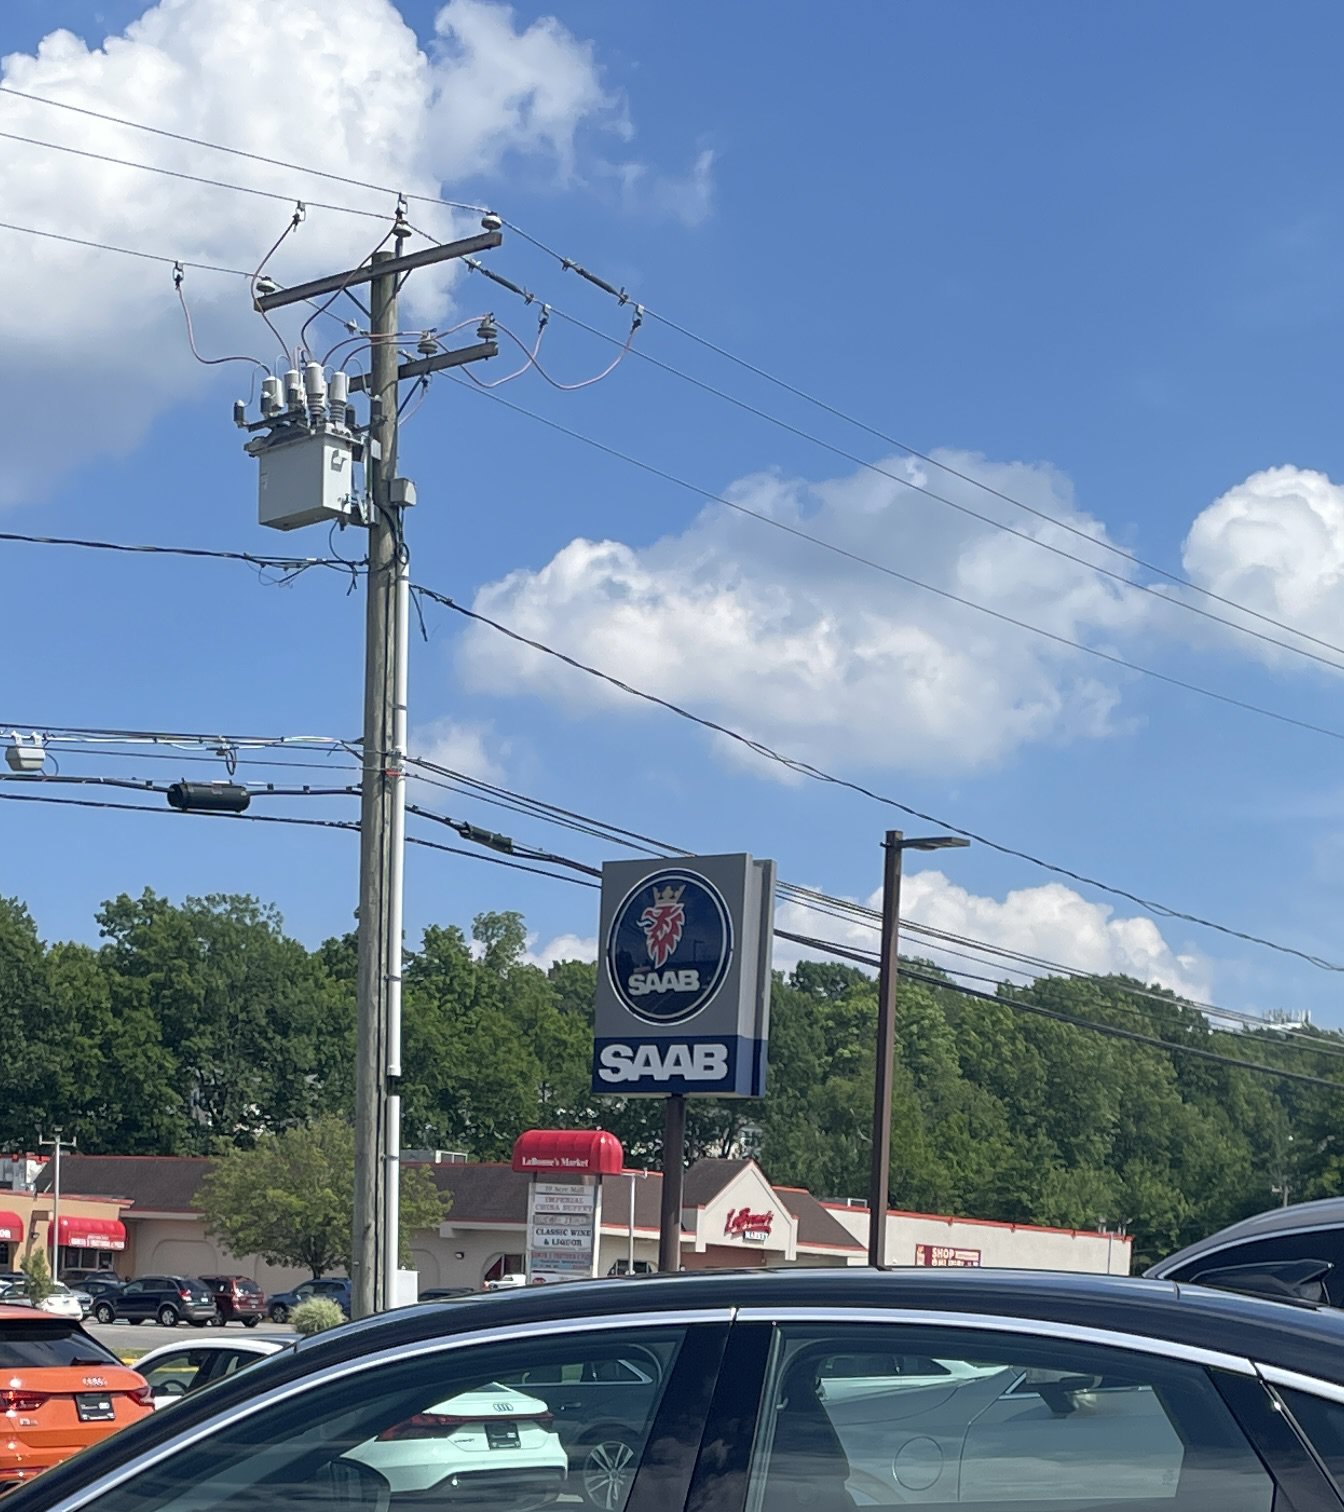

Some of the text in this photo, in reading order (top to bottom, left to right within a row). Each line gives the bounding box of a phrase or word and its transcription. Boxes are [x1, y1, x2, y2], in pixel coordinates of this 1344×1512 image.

[628, 970, 700, 996] SAAB
[598, 1043, 728, 1083] SAAB
[561, 1157, 589, 1167] Market
[536, 1228, 592, 1237] CLASSIC WINE
[931, 1247, 955, 1260] SHOP
